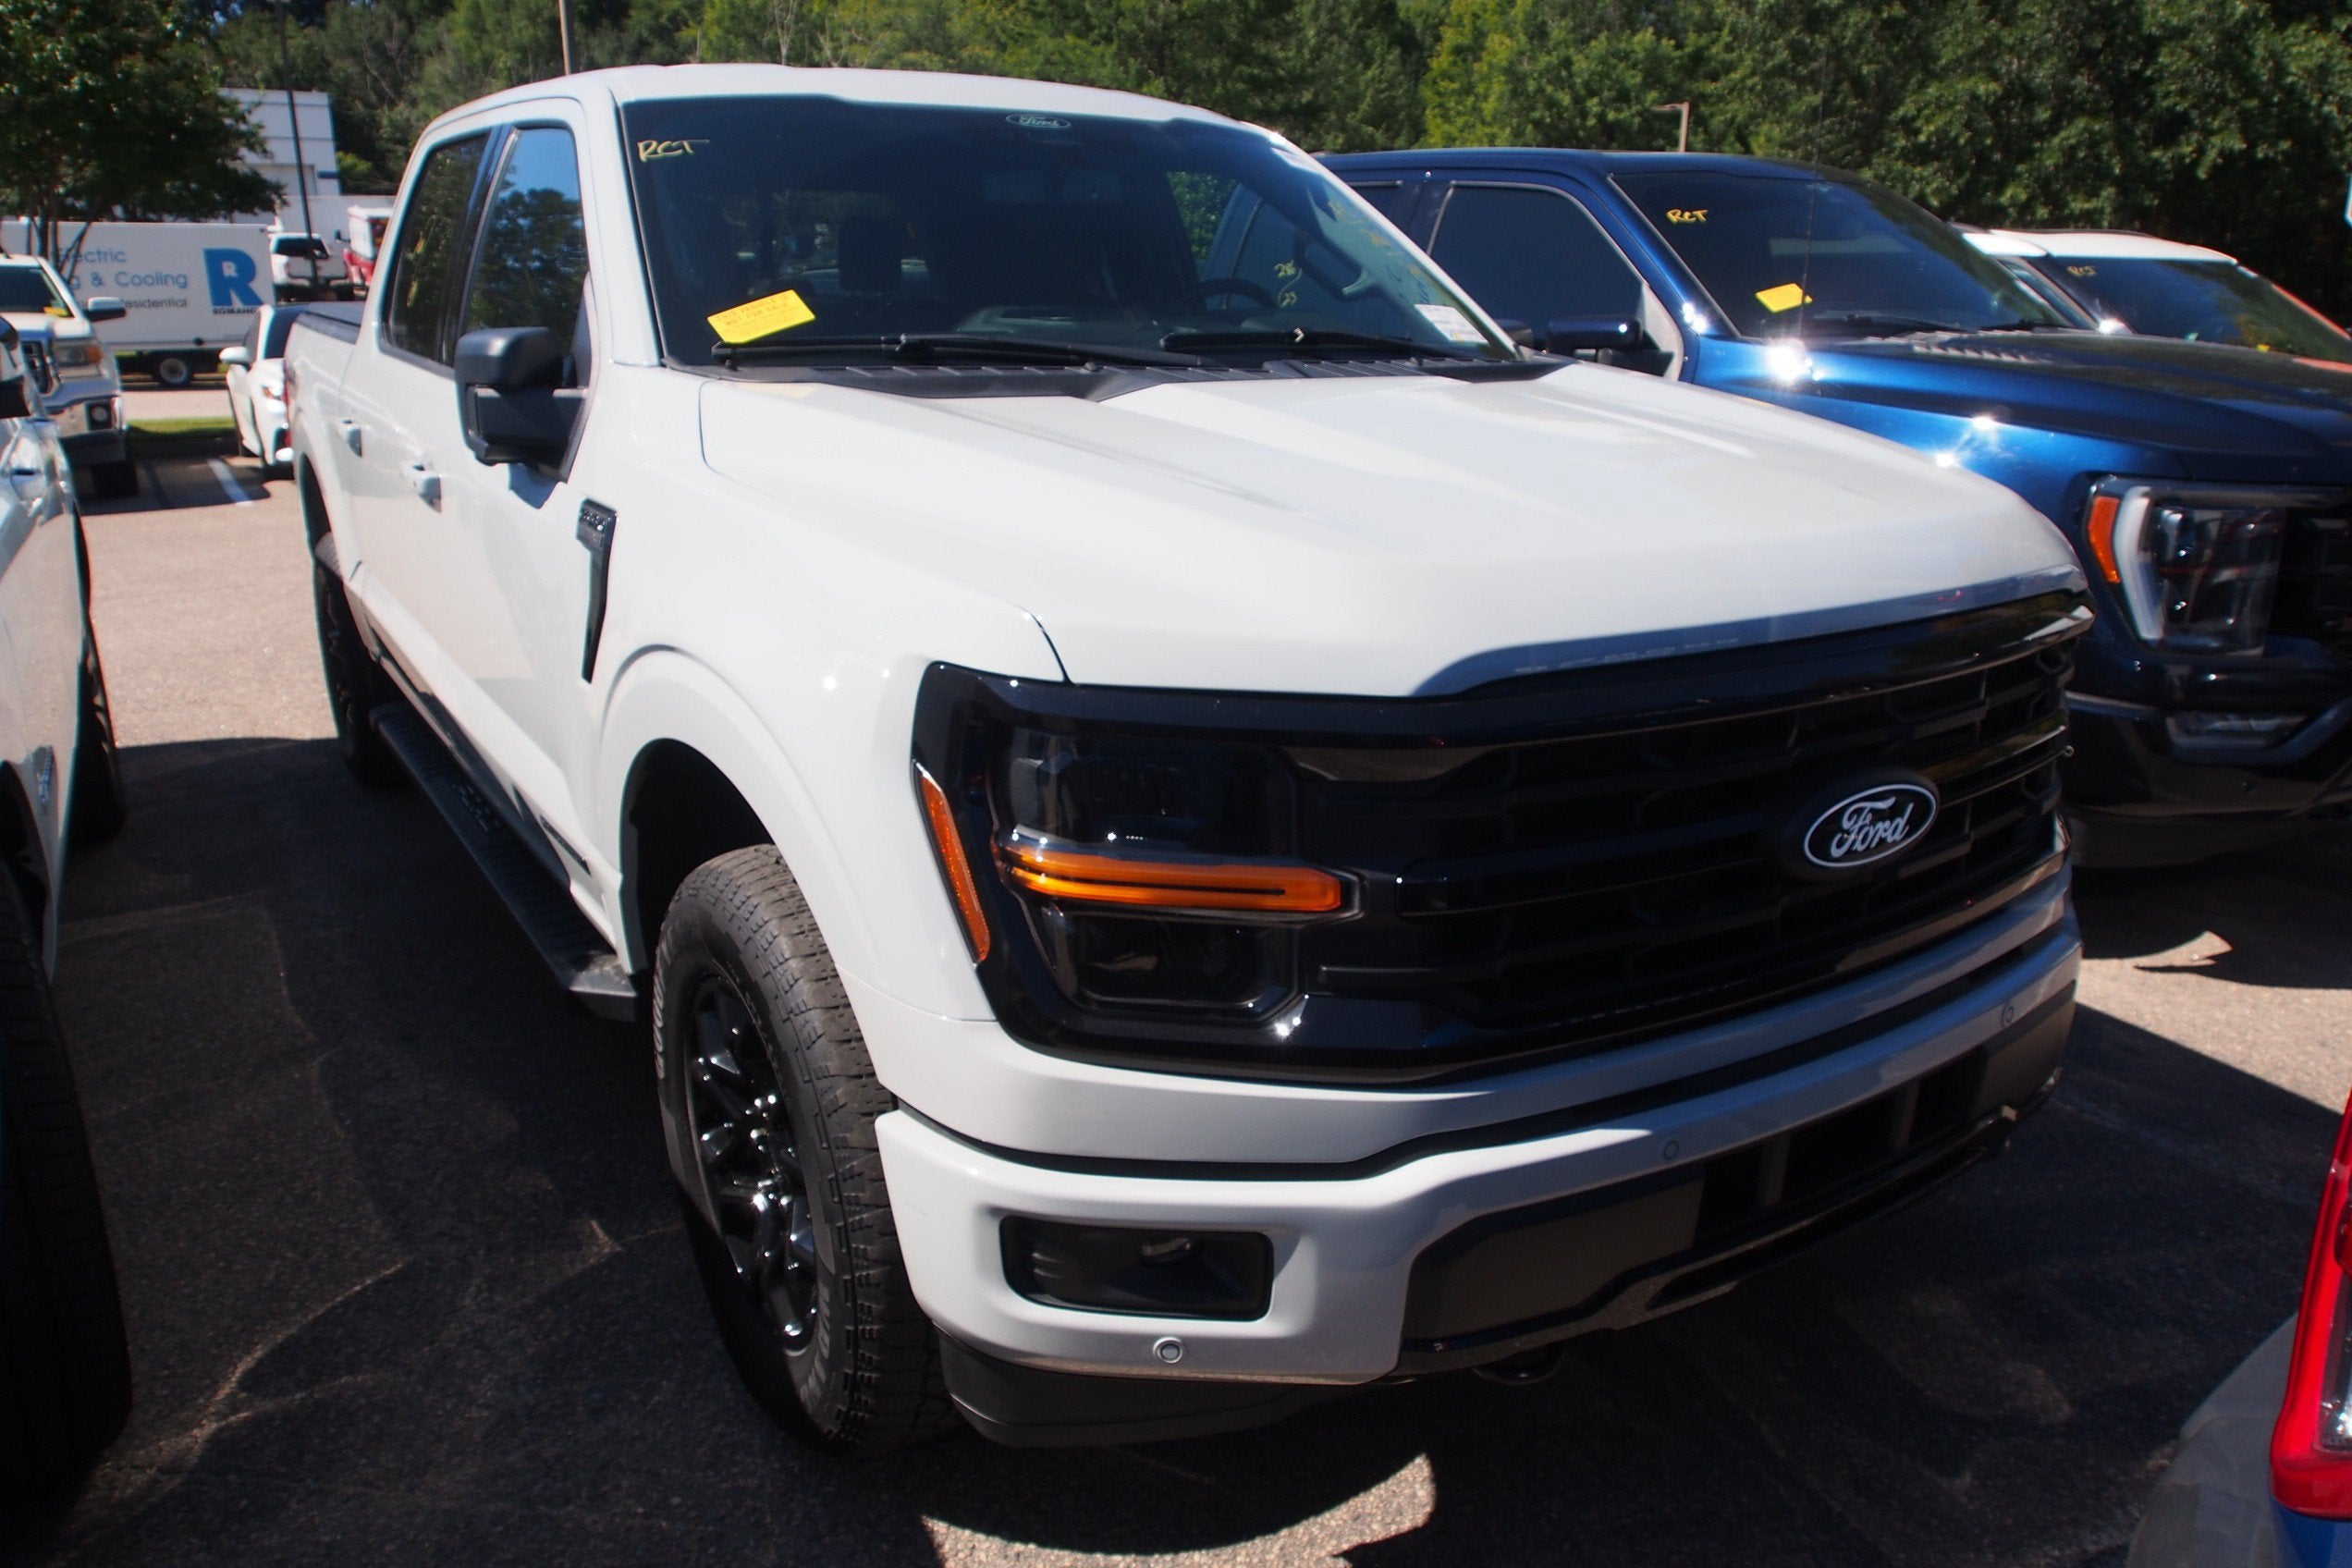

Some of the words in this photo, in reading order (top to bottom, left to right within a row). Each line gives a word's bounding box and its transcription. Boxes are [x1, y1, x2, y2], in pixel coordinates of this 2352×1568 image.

[637, 139, 710, 163] RCT
[1666, 209, 1709, 225] RCT
[91, 271, 104, 287] &
[115, 270, 189, 290] Cooling
[203, 247, 263, 307] R
[121, 297, 188, 309] esidential
